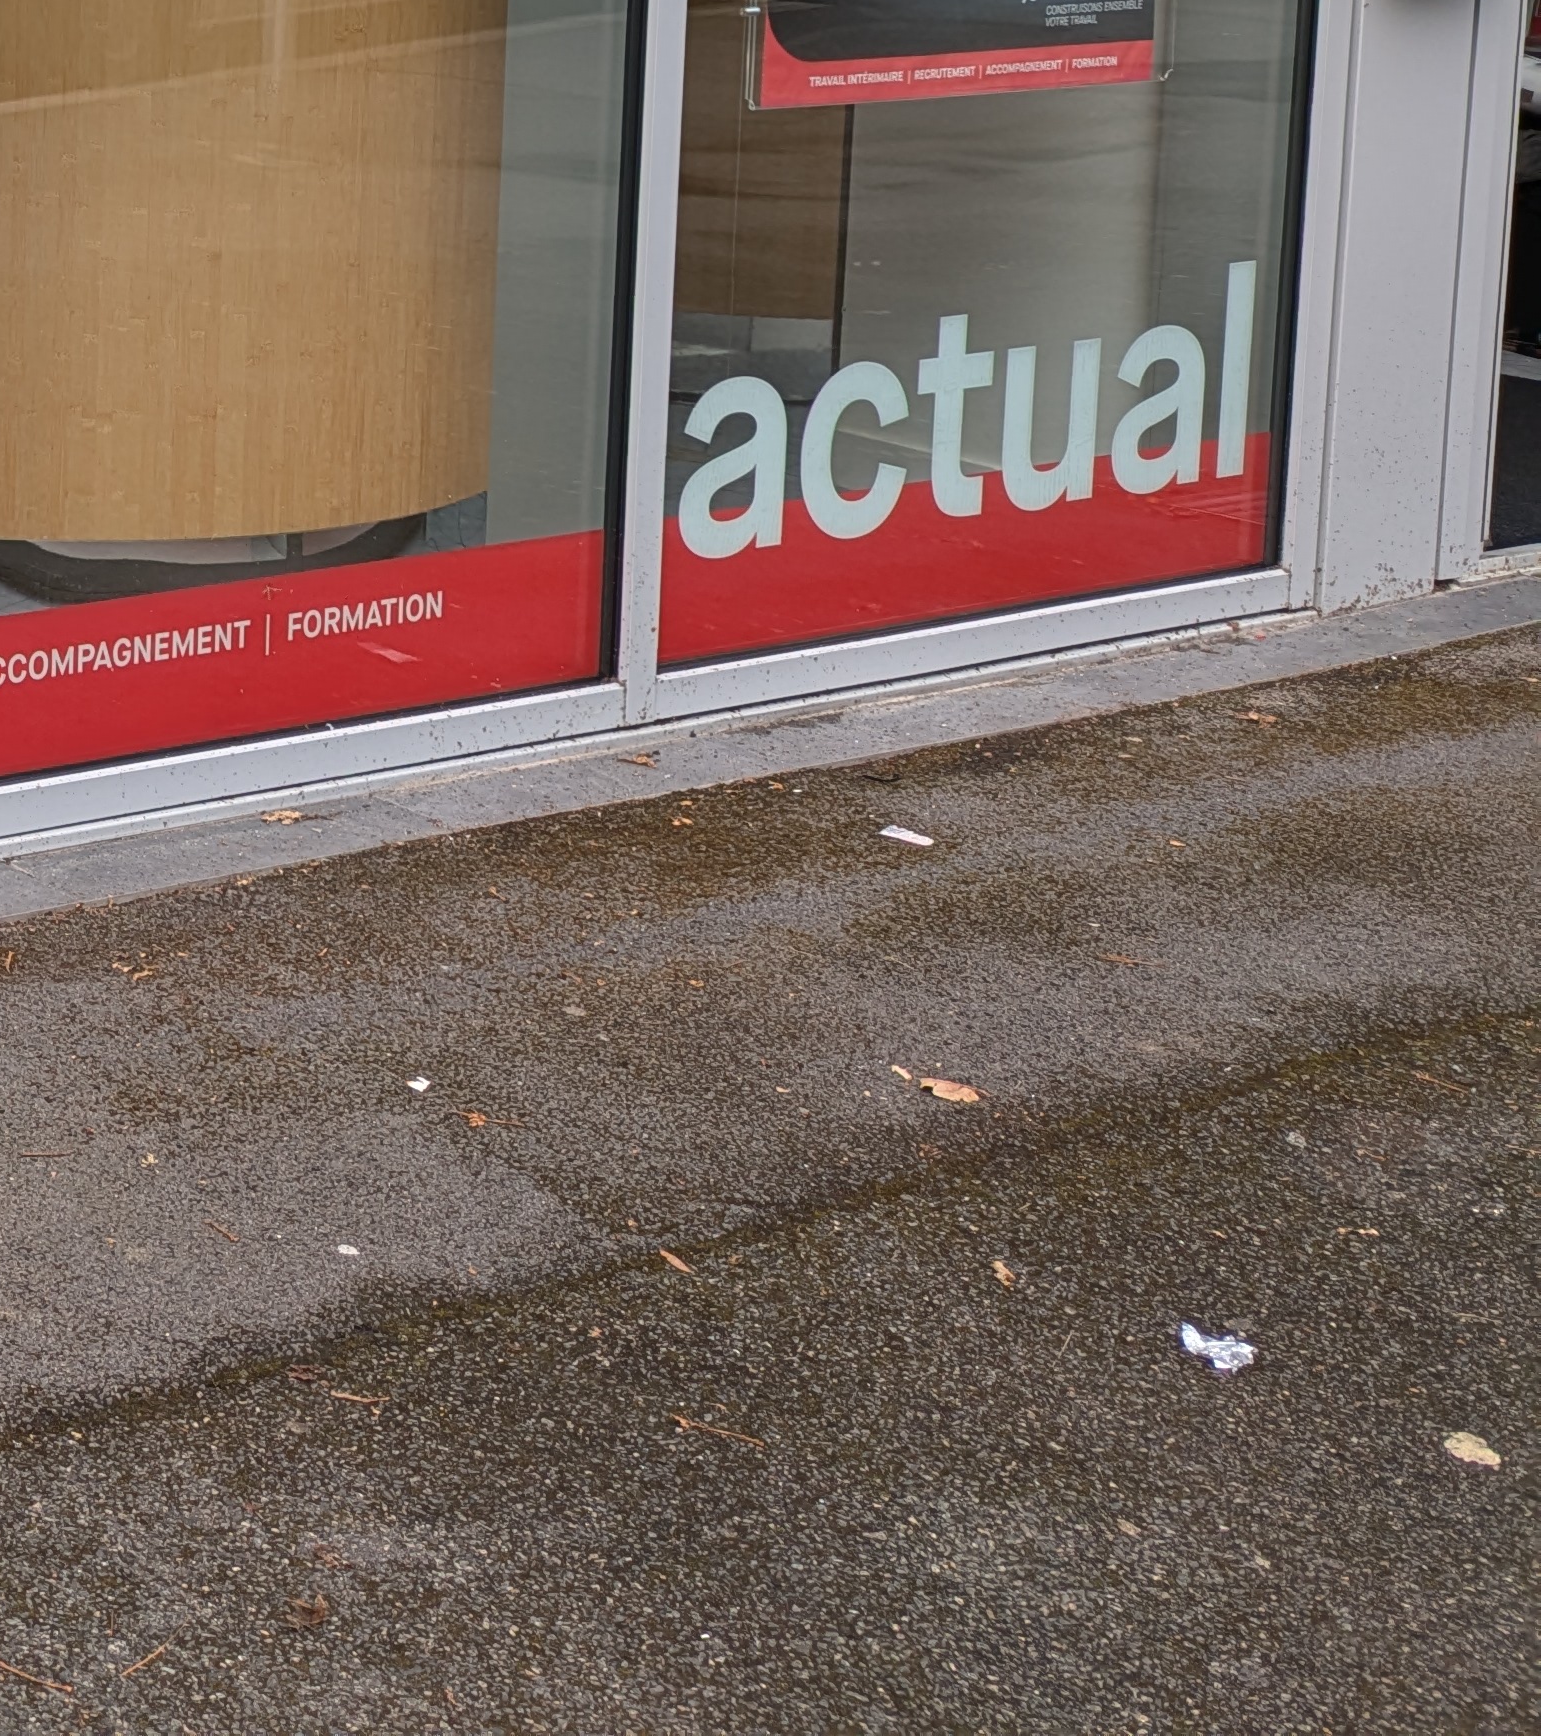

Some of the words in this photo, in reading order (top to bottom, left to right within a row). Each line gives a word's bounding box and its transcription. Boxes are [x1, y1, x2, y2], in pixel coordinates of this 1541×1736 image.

[1045, 16, 1068, 27] VOTRE
[1070, 14, 1097, 25] TRAVAIL
[1046, 2, 1103, 16] CONSTRUISONS
[1104, 0, 1143, 12] ENSEMBLE
[809, 75, 846, 88] TRAVAIL
[848, 69, 903, 84] INTÉRIMAIRE
[914, 65, 976, 80] RECRUTEMENT
[985, 59, 1062, 76] ACCOMPAGNEMENT
[1072, 56, 1118, 69] FORMATION
[678, 260, 1256, 559] actual
[287, 590, 443, 642] FORMATION
